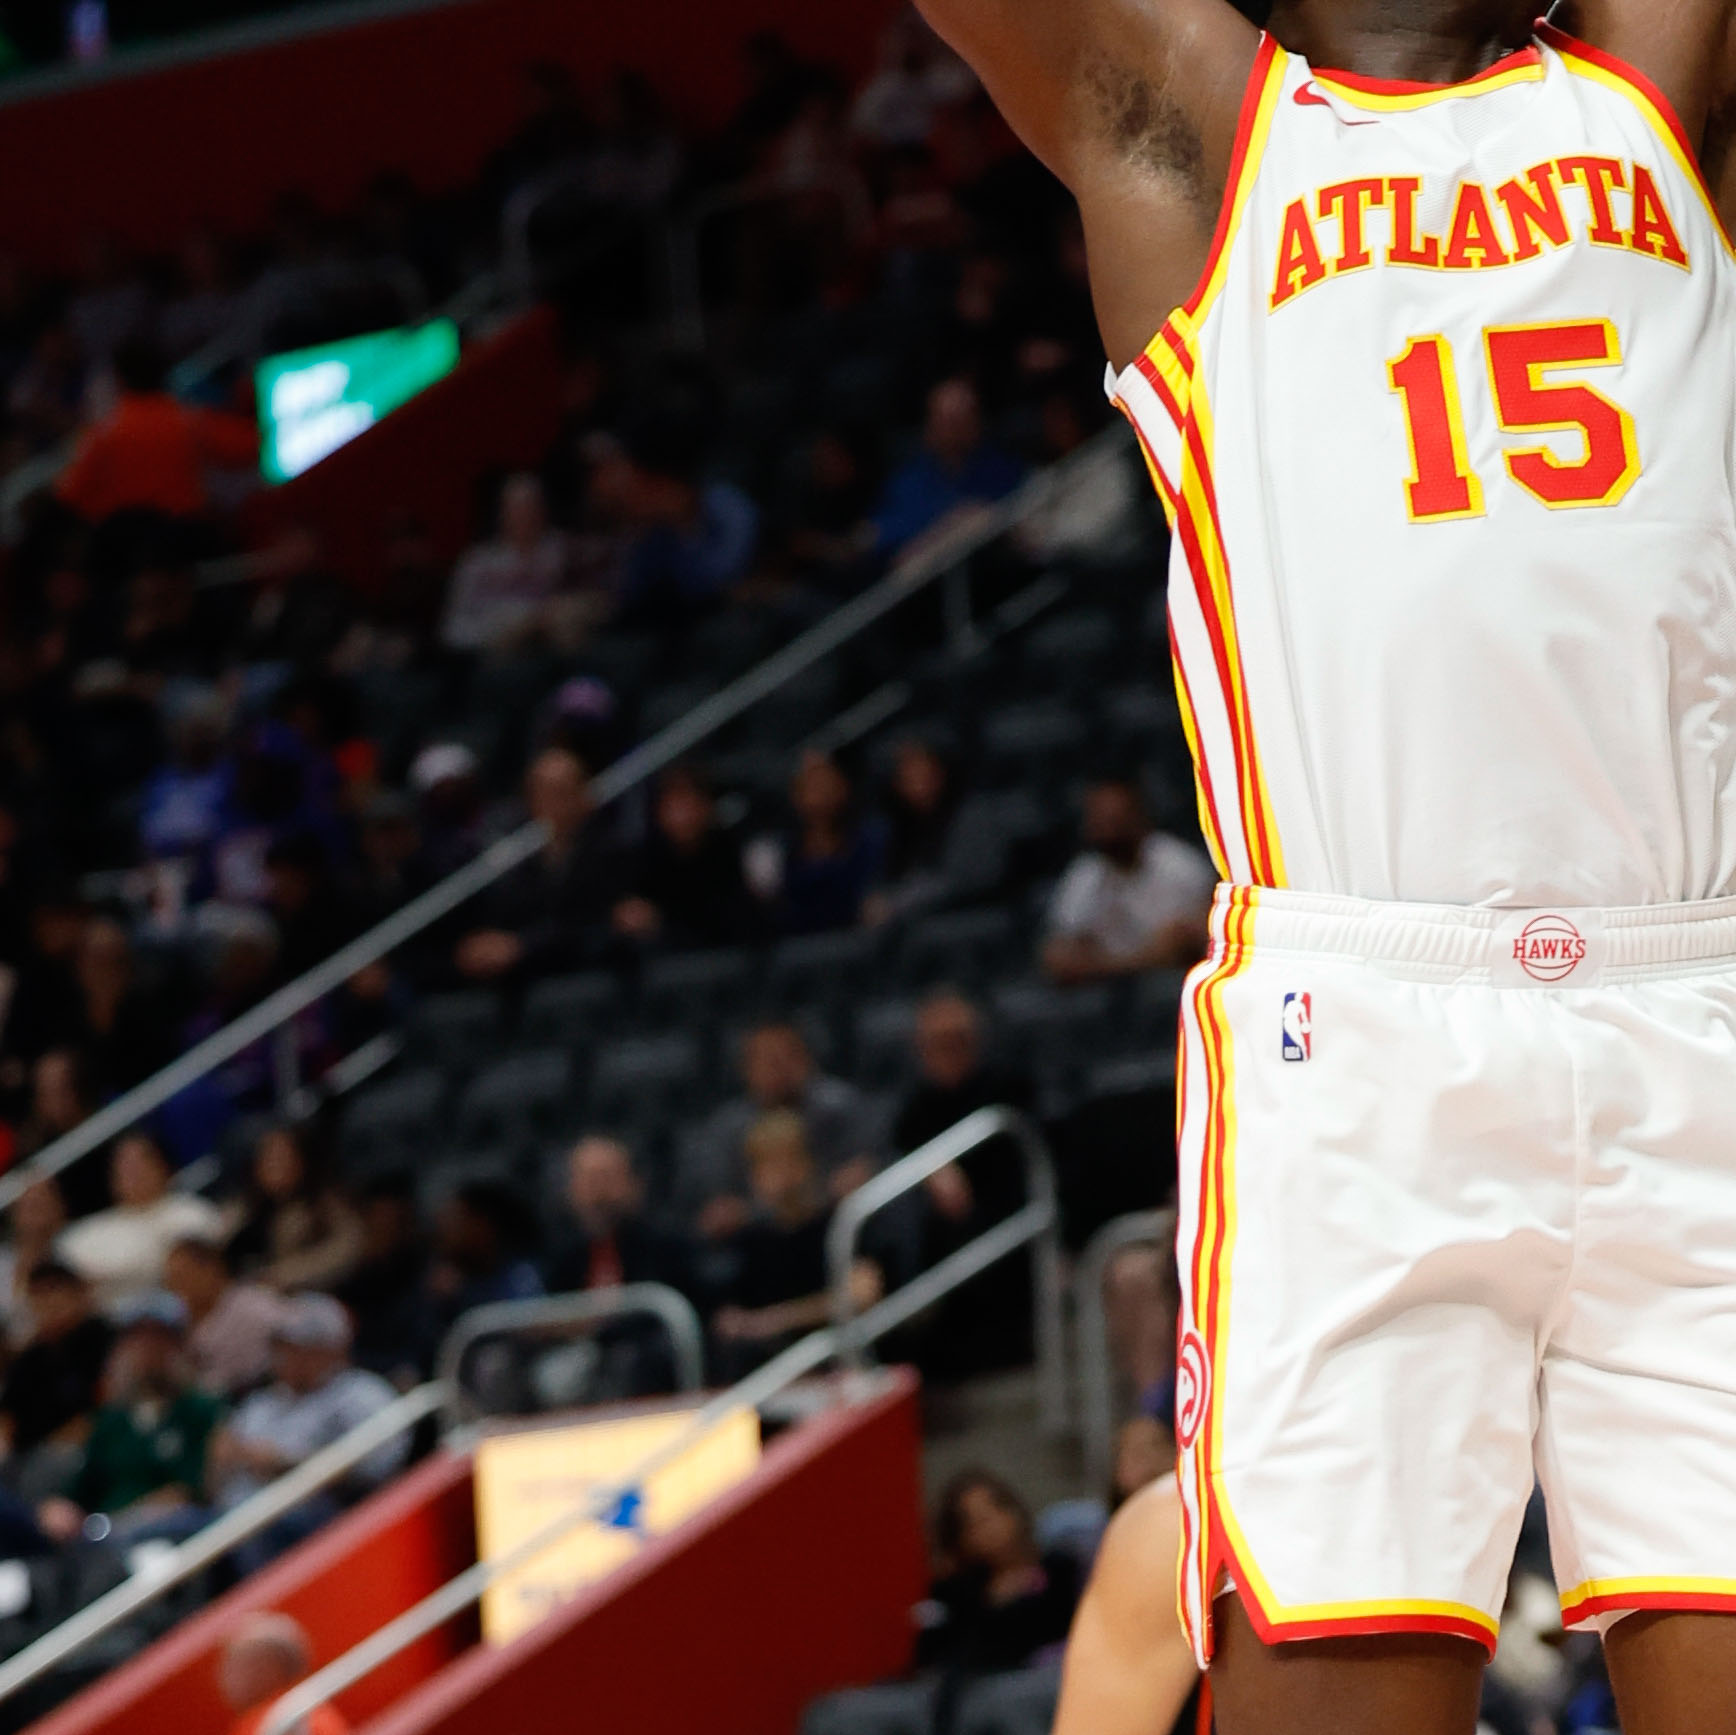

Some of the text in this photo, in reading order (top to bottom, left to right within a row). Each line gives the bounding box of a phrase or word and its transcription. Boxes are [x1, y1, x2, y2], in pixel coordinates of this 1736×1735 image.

[1268, 155, 1692, 315] ATLANTA
[1386, 318, 1642, 525] 15
[1512, 938, 1587, 959] HAWKS
